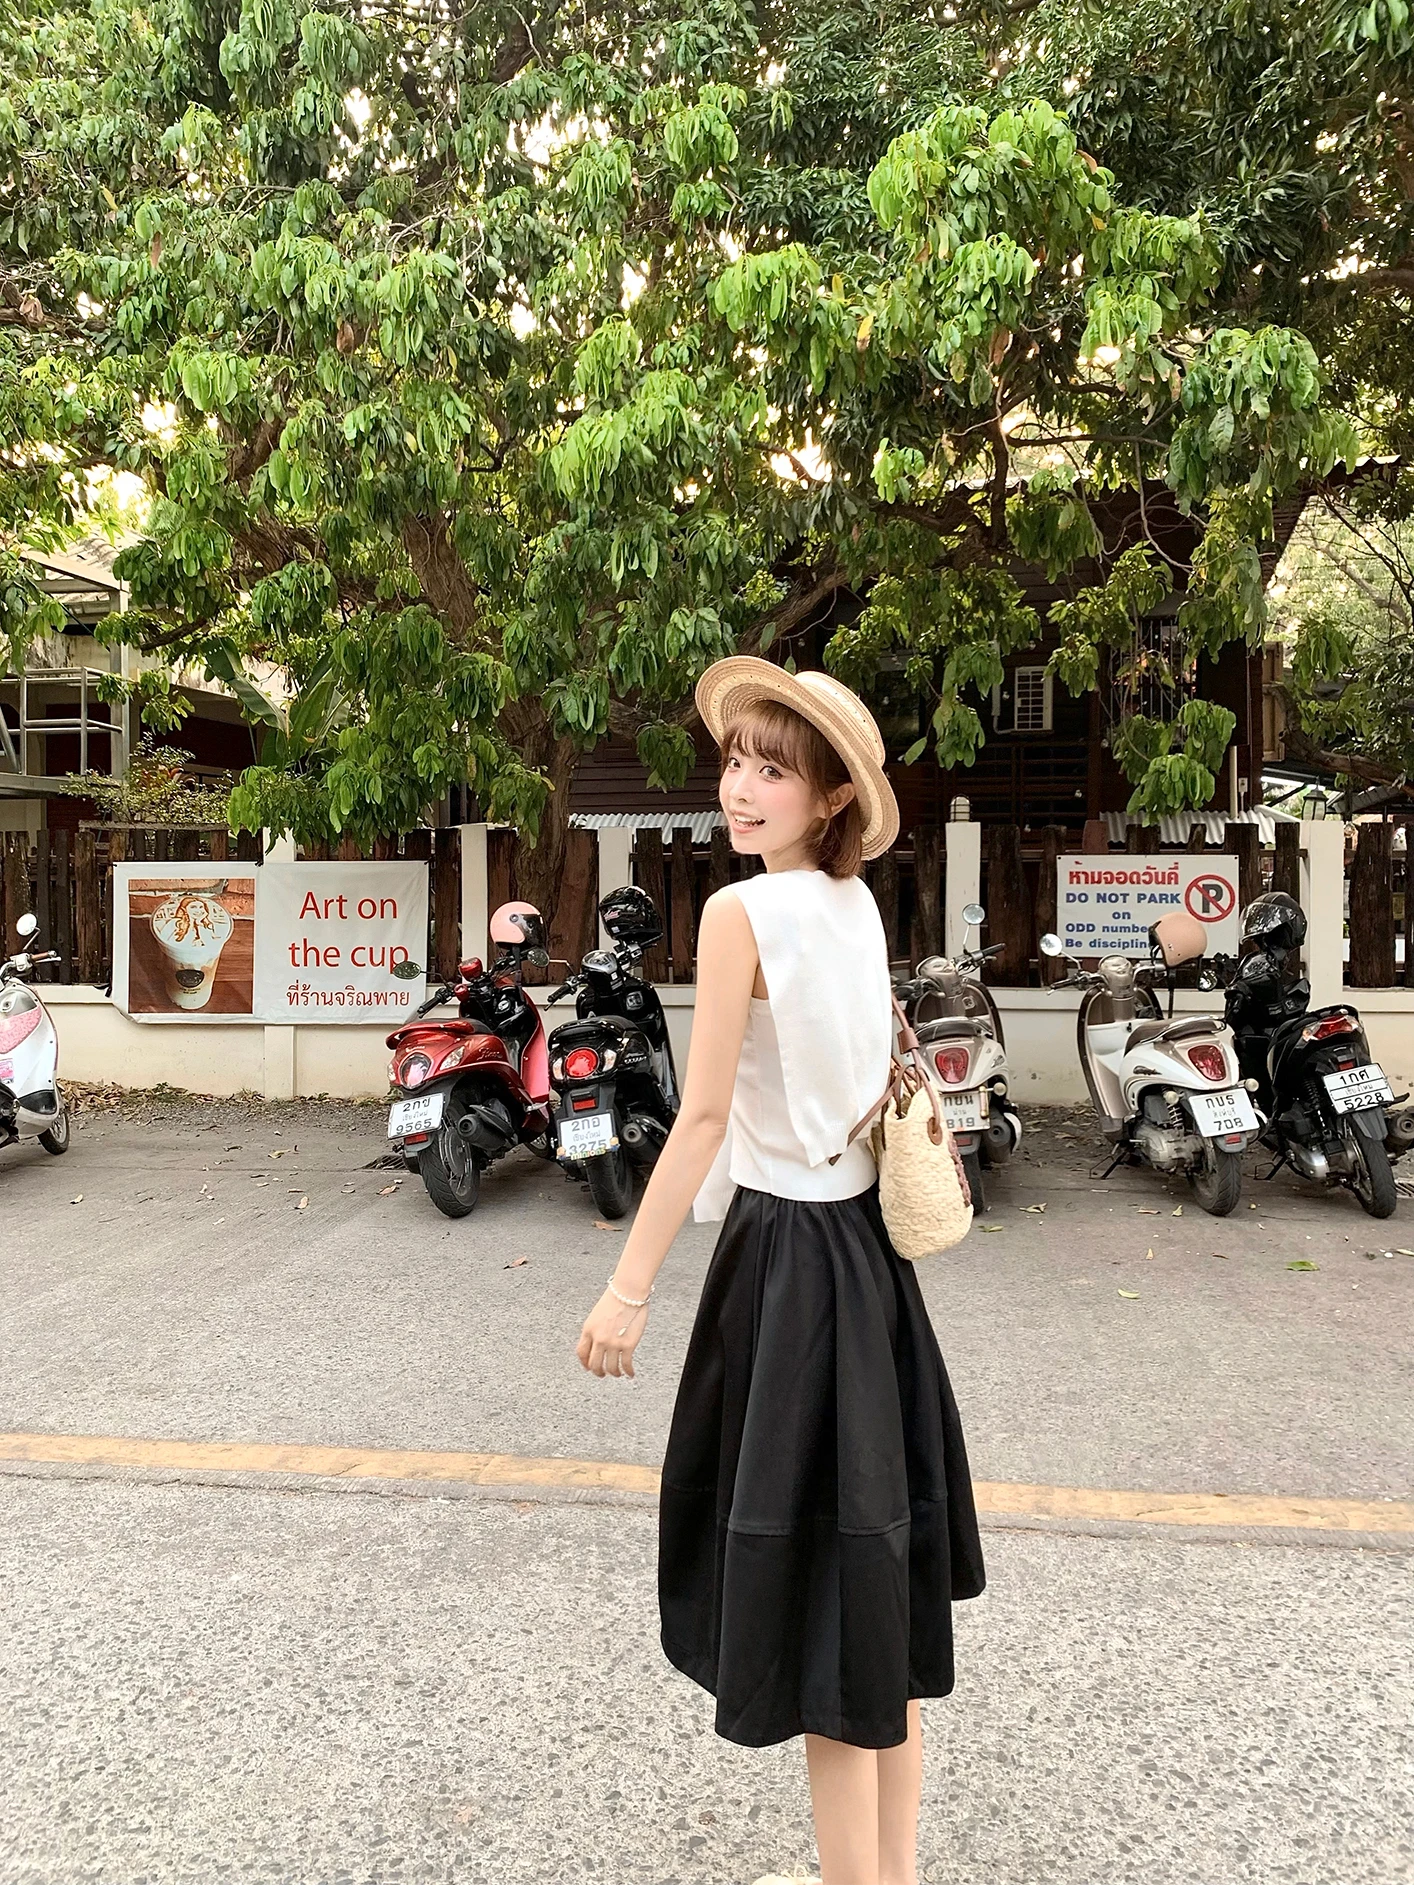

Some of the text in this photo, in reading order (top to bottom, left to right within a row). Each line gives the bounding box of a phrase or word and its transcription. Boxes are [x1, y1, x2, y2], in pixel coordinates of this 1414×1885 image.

[1068, 860, 1179, 885] ห้ามจอดวันคี่
[299, 891, 398, 920] Art on
[1066, 893, 1181, 904] DO NOT PARK
[1112, 911, 1131, 920] on
[1065, 923, 1149, 933] ODD numbe
[1065, 938, 1151, 950] Be disciplin
[288, 937, 409, 975] the cup
[286, 979, 410, 1006] ที่ร้านจริณพาย
[1344, 1092, 1384, 1110] 5228
[396, 1117, 432, 1136] 9565
[946, 1117, 975, 1129] 819
[1213, 1117, 1244, 1131] 708
